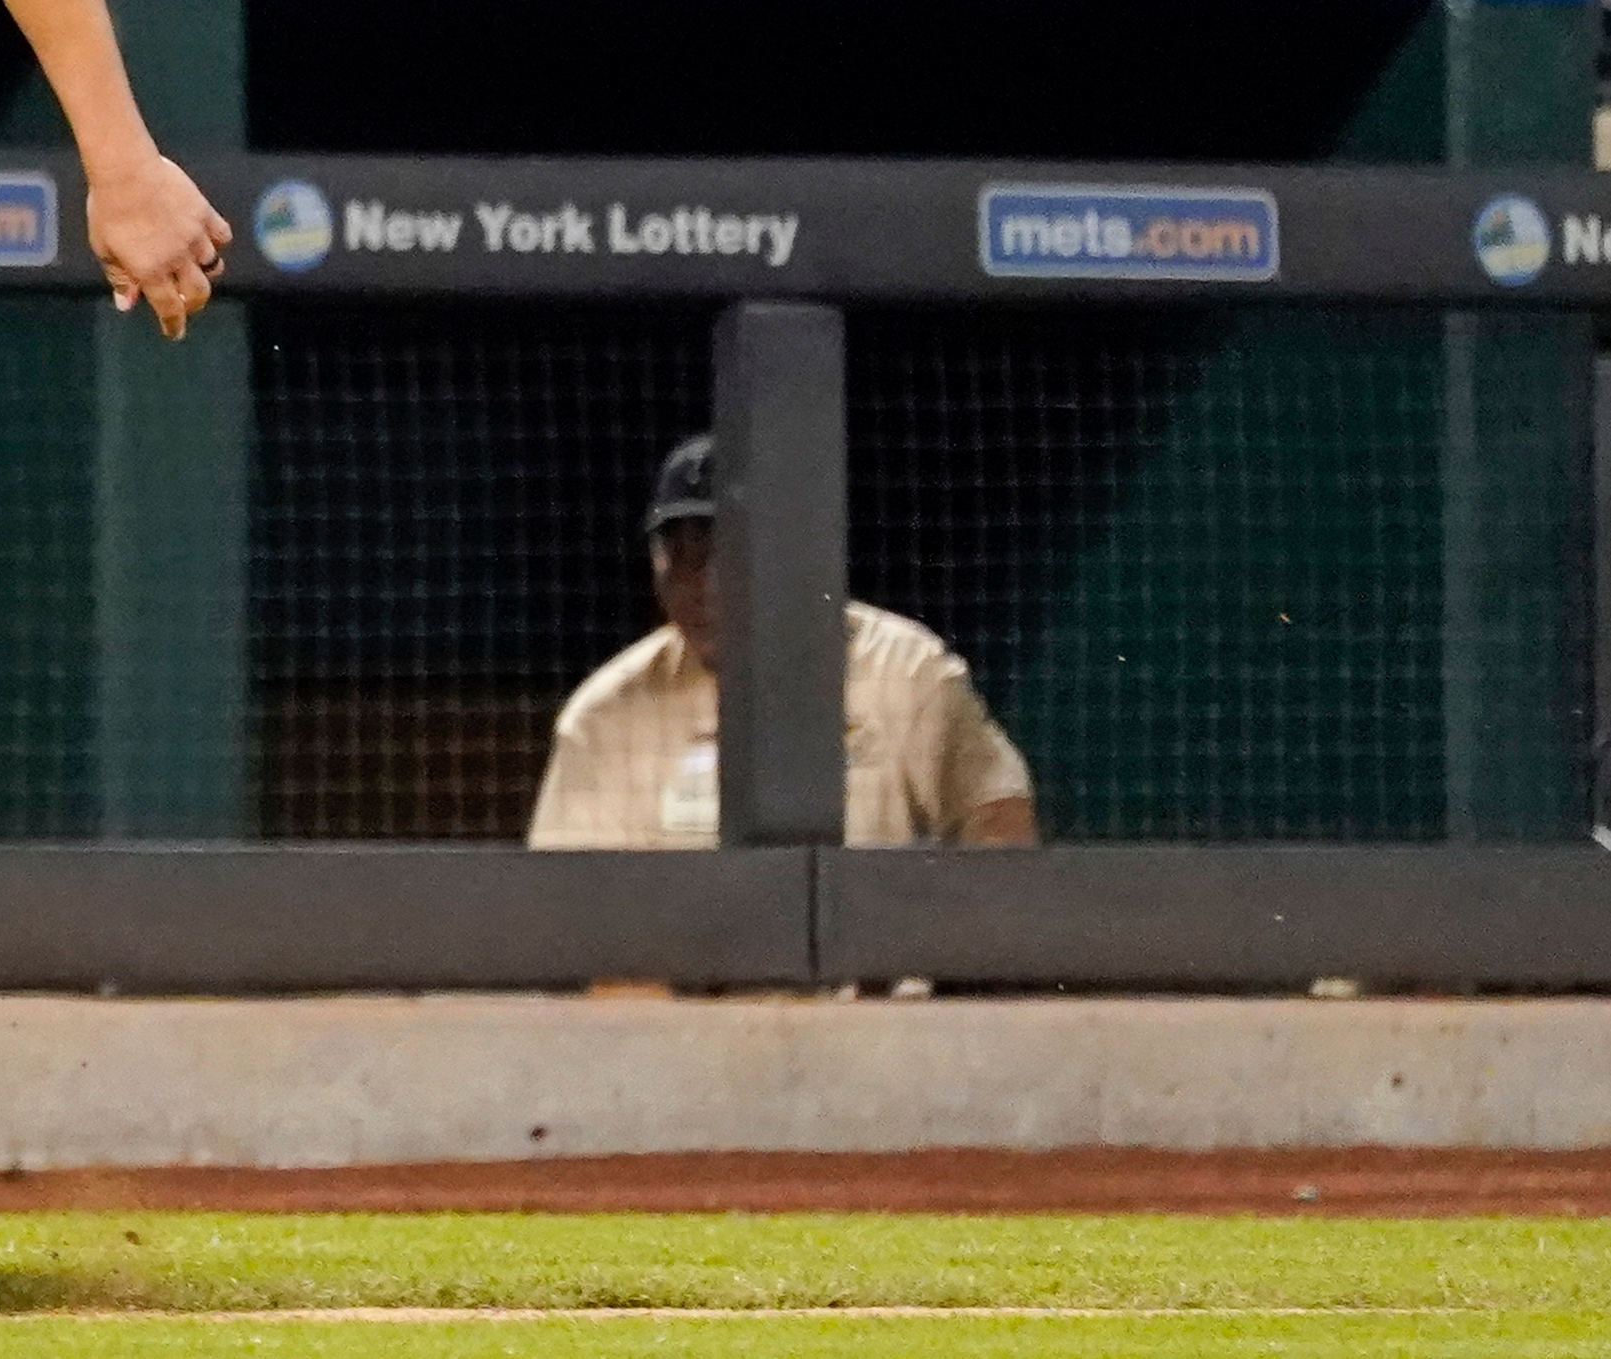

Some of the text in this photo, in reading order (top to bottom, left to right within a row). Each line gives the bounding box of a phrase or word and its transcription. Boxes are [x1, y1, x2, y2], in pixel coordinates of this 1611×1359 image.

[344, 199, 799, 267] New York Lottery
[1001, 208, 1260, 258] mets.com
